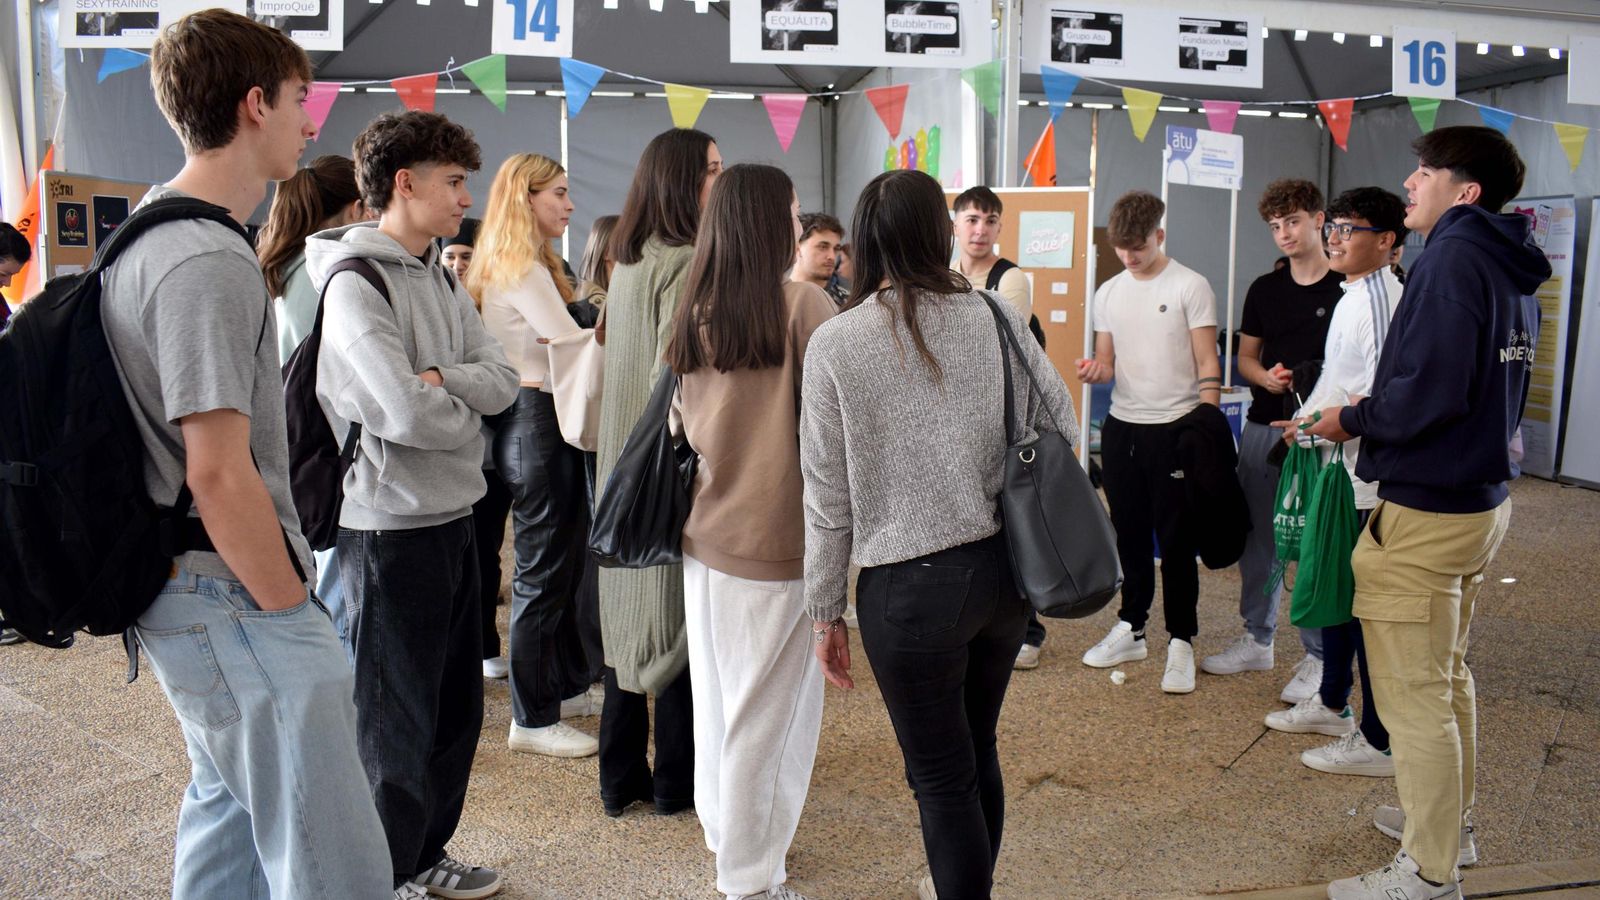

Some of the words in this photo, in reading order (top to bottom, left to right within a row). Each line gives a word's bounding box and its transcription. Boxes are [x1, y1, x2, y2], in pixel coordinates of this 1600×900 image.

[76, 0, 159, 8] SEXYTRAINING
[506, 0, 560, 42] 14
[891, 18, 952, 30] BubbleTime
[1066, 31, 1091, 42] Grupo
[1201, 49, 1214, 57] For
[1403, 39, 1446, 87] 16
